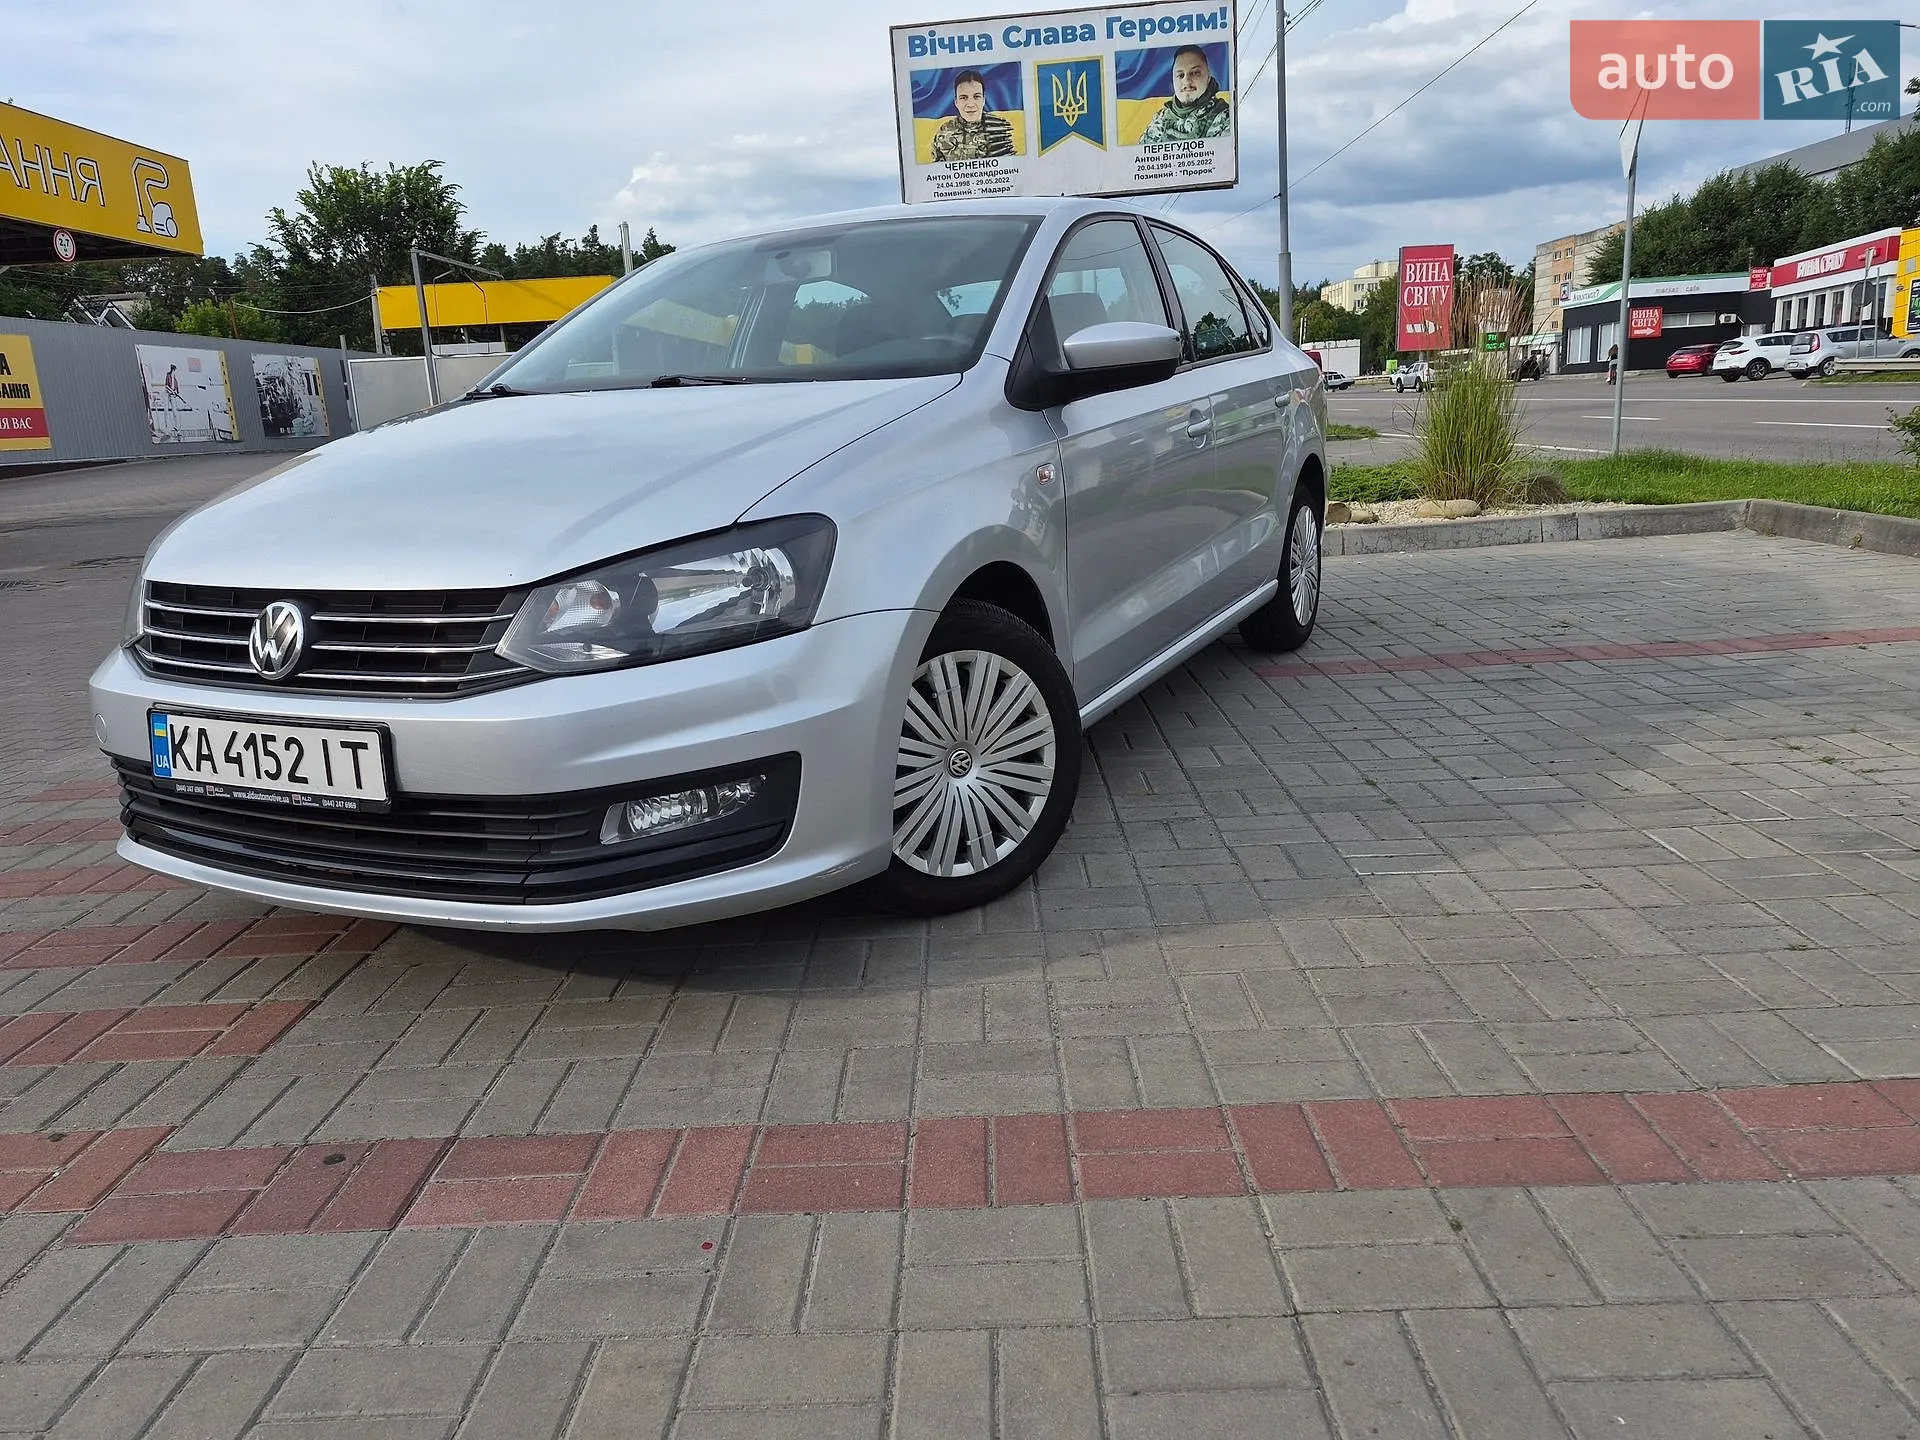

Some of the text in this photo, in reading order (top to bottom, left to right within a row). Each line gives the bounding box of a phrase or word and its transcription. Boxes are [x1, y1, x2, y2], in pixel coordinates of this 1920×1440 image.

[907, 7, 1228, 58] Вічна Слава Героям!
[1144, 141, 1205, 154] ПЕРЕГУДОВ
[1162, 150, 1215, 161] Віталійович
[945, 159, 999, 171] ЧЕРНЕНКО
[1137, 163, 1172, 171] 20.04.1994
[1177, 159, 1213, 168] 29.05.2022
[926, 168, 1019, 182] Антон Олександрович
[976, 177, 1011, 185] 29.05.2022
[1134, 171, 1173, 180] Позивний
[933, 188, 972, 198] Позивний
[1404, 261, 1450, 283] ВИНА
[1403, 285, 1450, 306] СВІТУ
[1632, 309, 1659, 319] ВИНА
[1632, 318, 1659, 328] СВІТУ
[11, 417, 33, 430] ВАС
[156, 754, 170, 769] UA
[169, 724, 369, 790] KA 4152 IT
